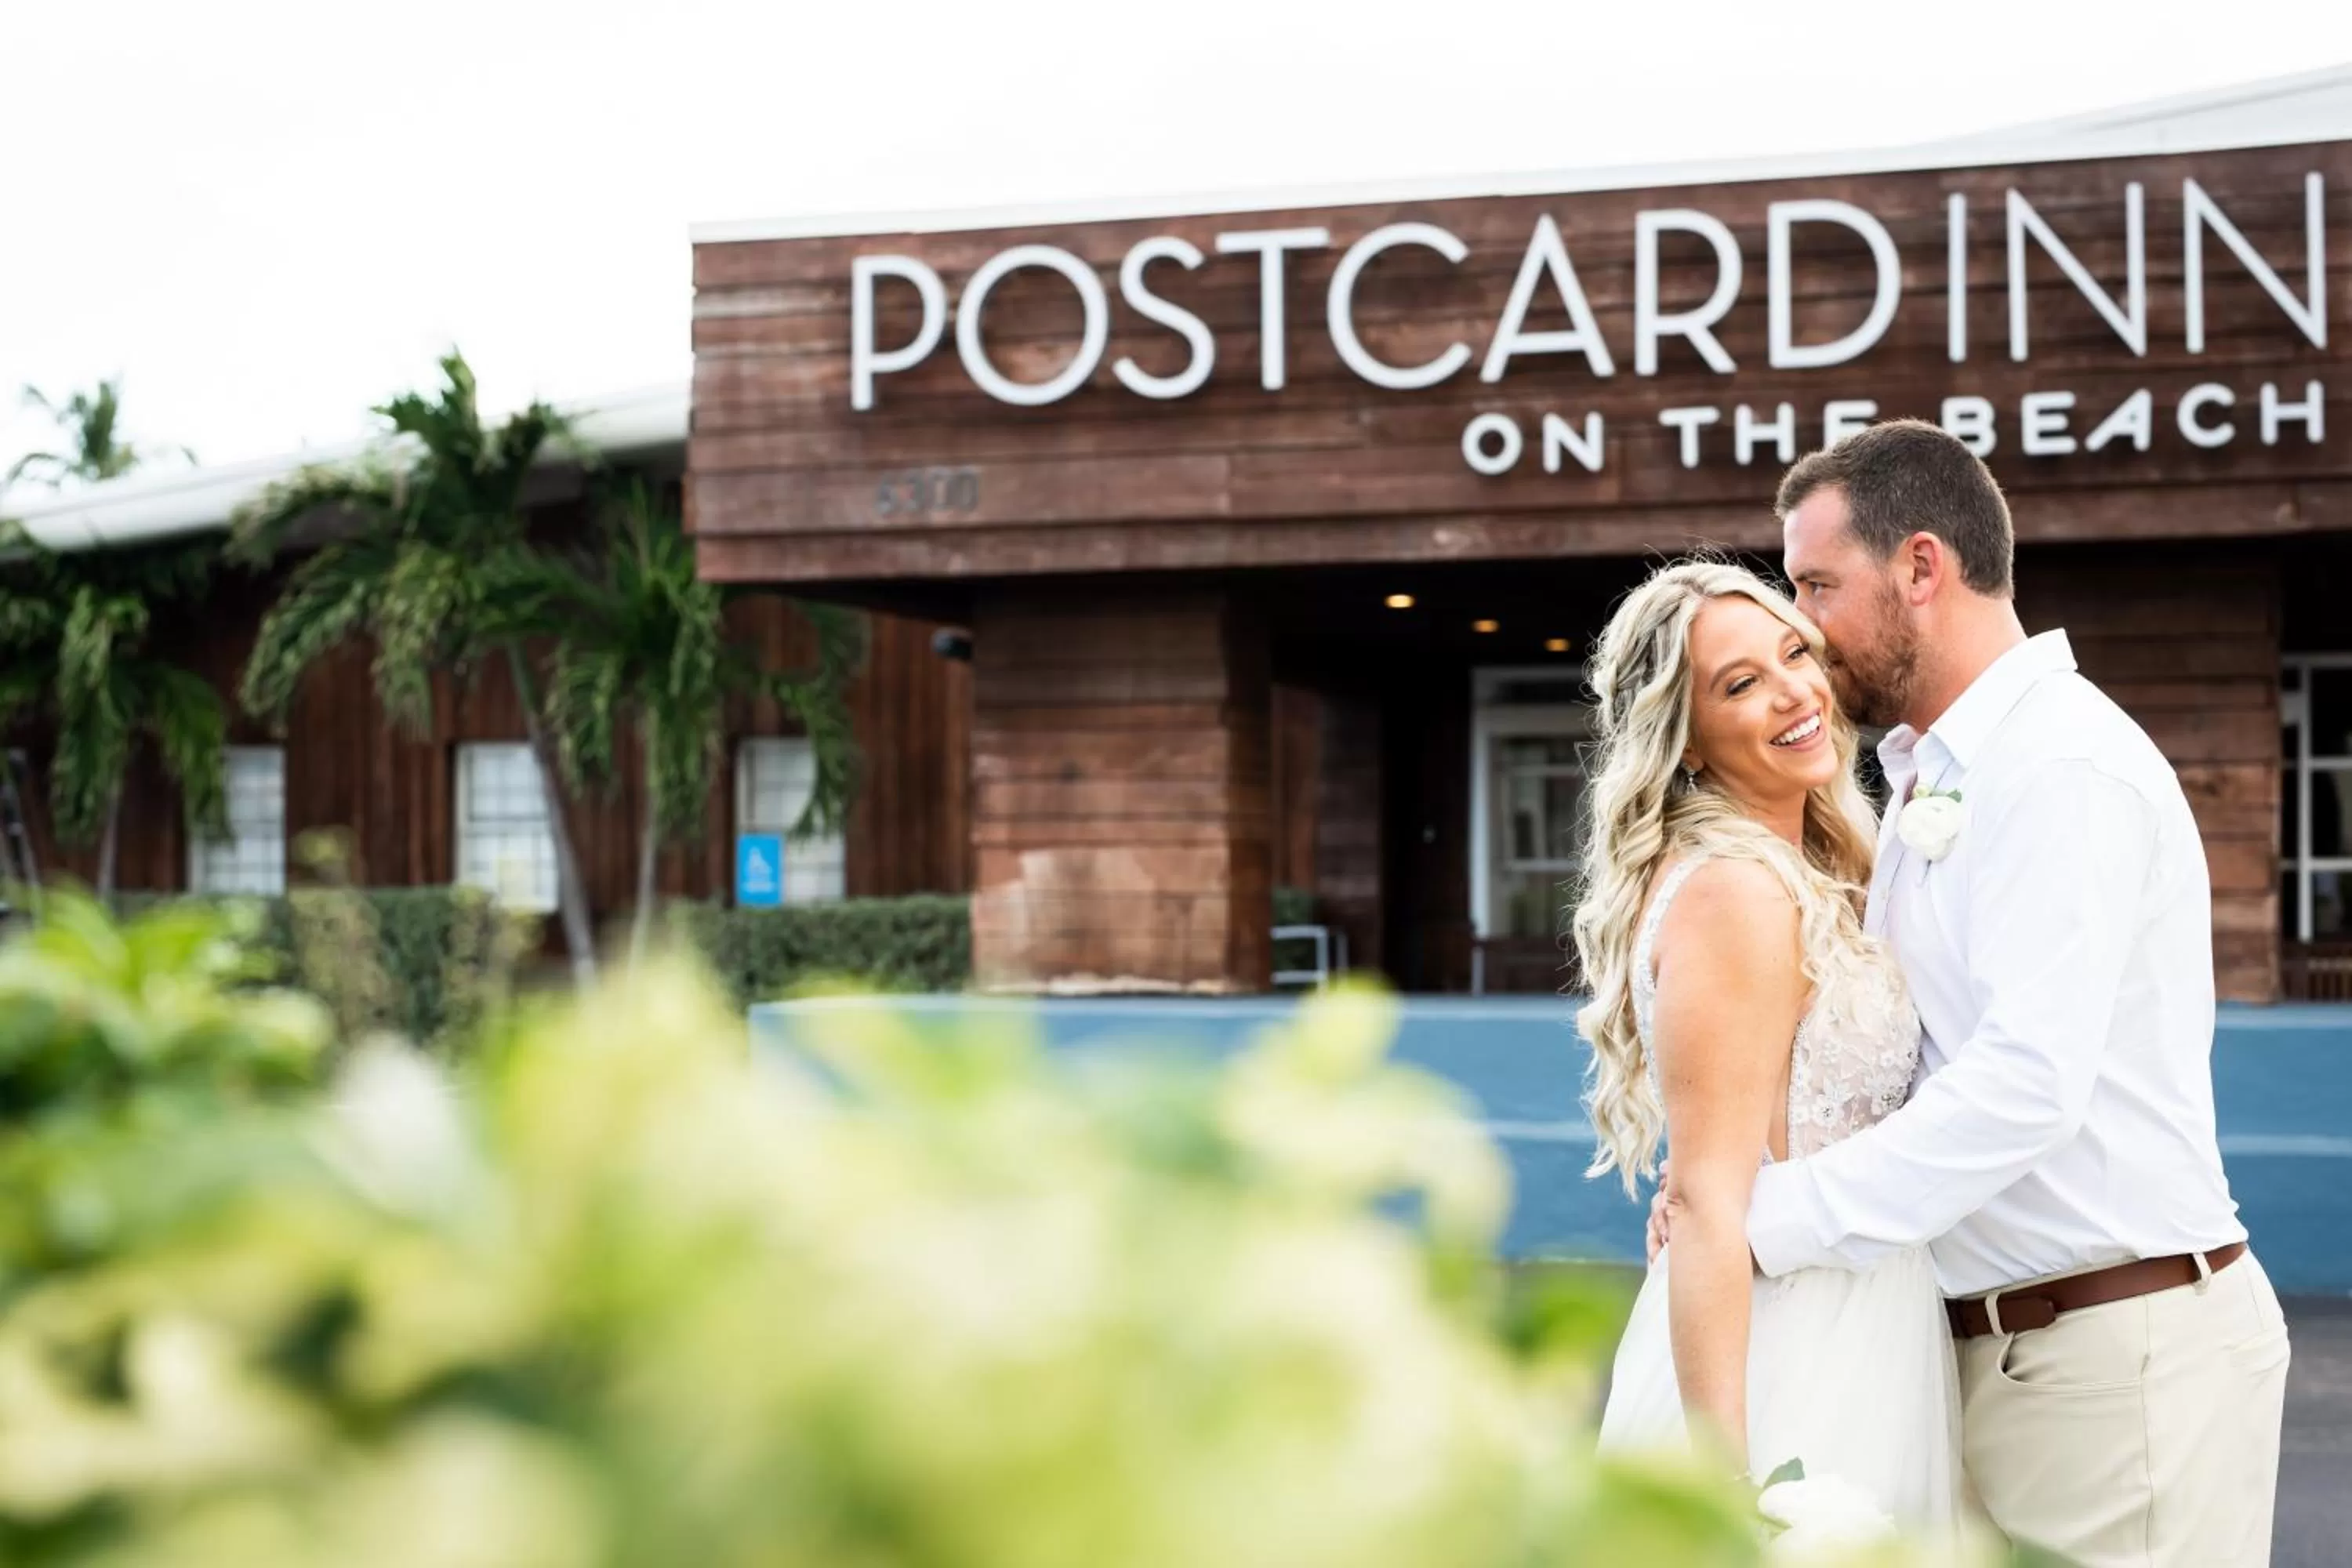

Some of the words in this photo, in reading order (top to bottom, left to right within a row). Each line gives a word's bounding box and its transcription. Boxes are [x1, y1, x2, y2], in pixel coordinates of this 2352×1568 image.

[850, 198, 1903, 411] POSTCARD
[1947, 172, 2327, 362] INN
[1461, 412, 1604, 474] ON
[1940, 381, 2324, 459] BEACH
